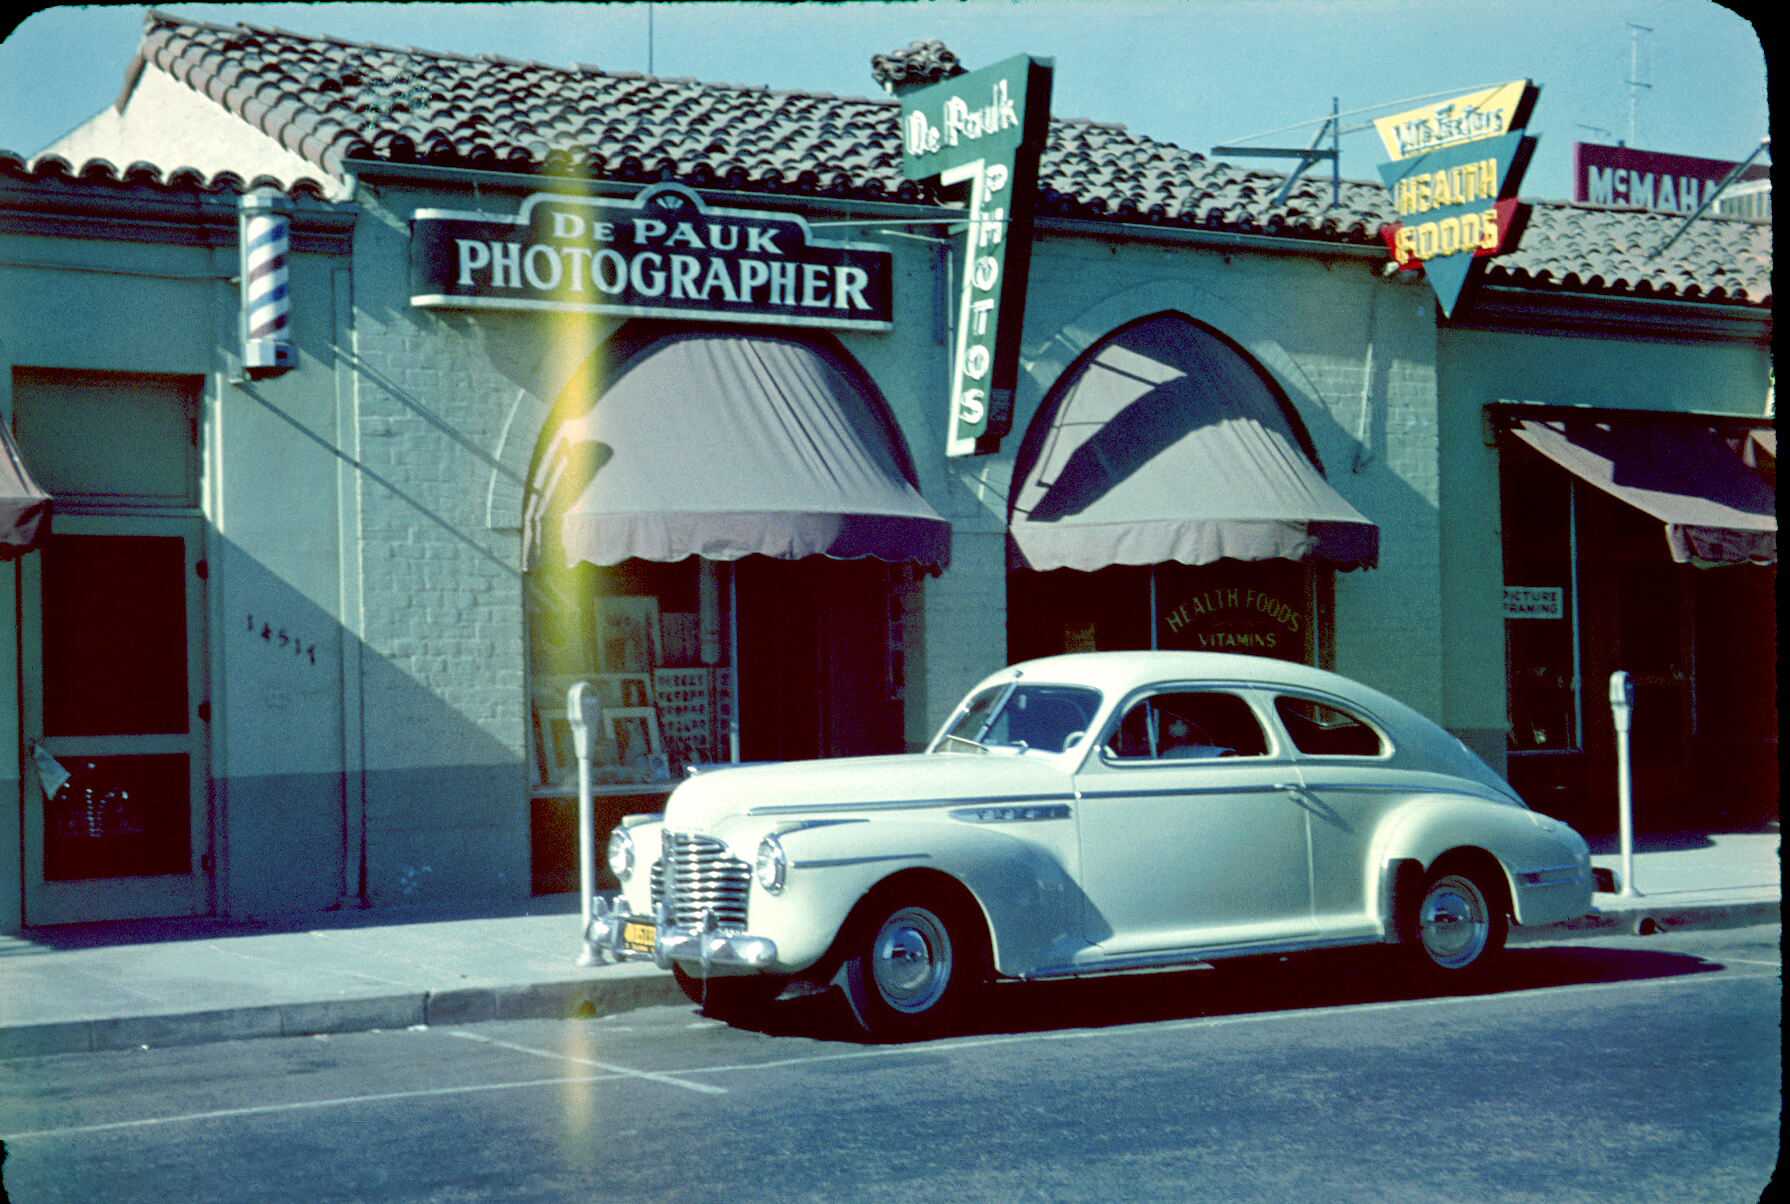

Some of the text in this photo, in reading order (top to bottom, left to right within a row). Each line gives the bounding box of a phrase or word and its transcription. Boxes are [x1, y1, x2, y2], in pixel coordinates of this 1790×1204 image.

[944, 79, 1019, 147] Pauk
[1394, 157, 1498, 216] HEALTH
[632, 217, 783, 255] PAUK
[1394, 208, 1499, 264] FOODS
[455, 238, 873, 311] PHOTOGRAPHER
[959, 163, 1009, 424] PHOTOS
[1166, 587, 1301, 633] HEALTH FOODS
[1198, 631, 1278, 649] VITAMINS
